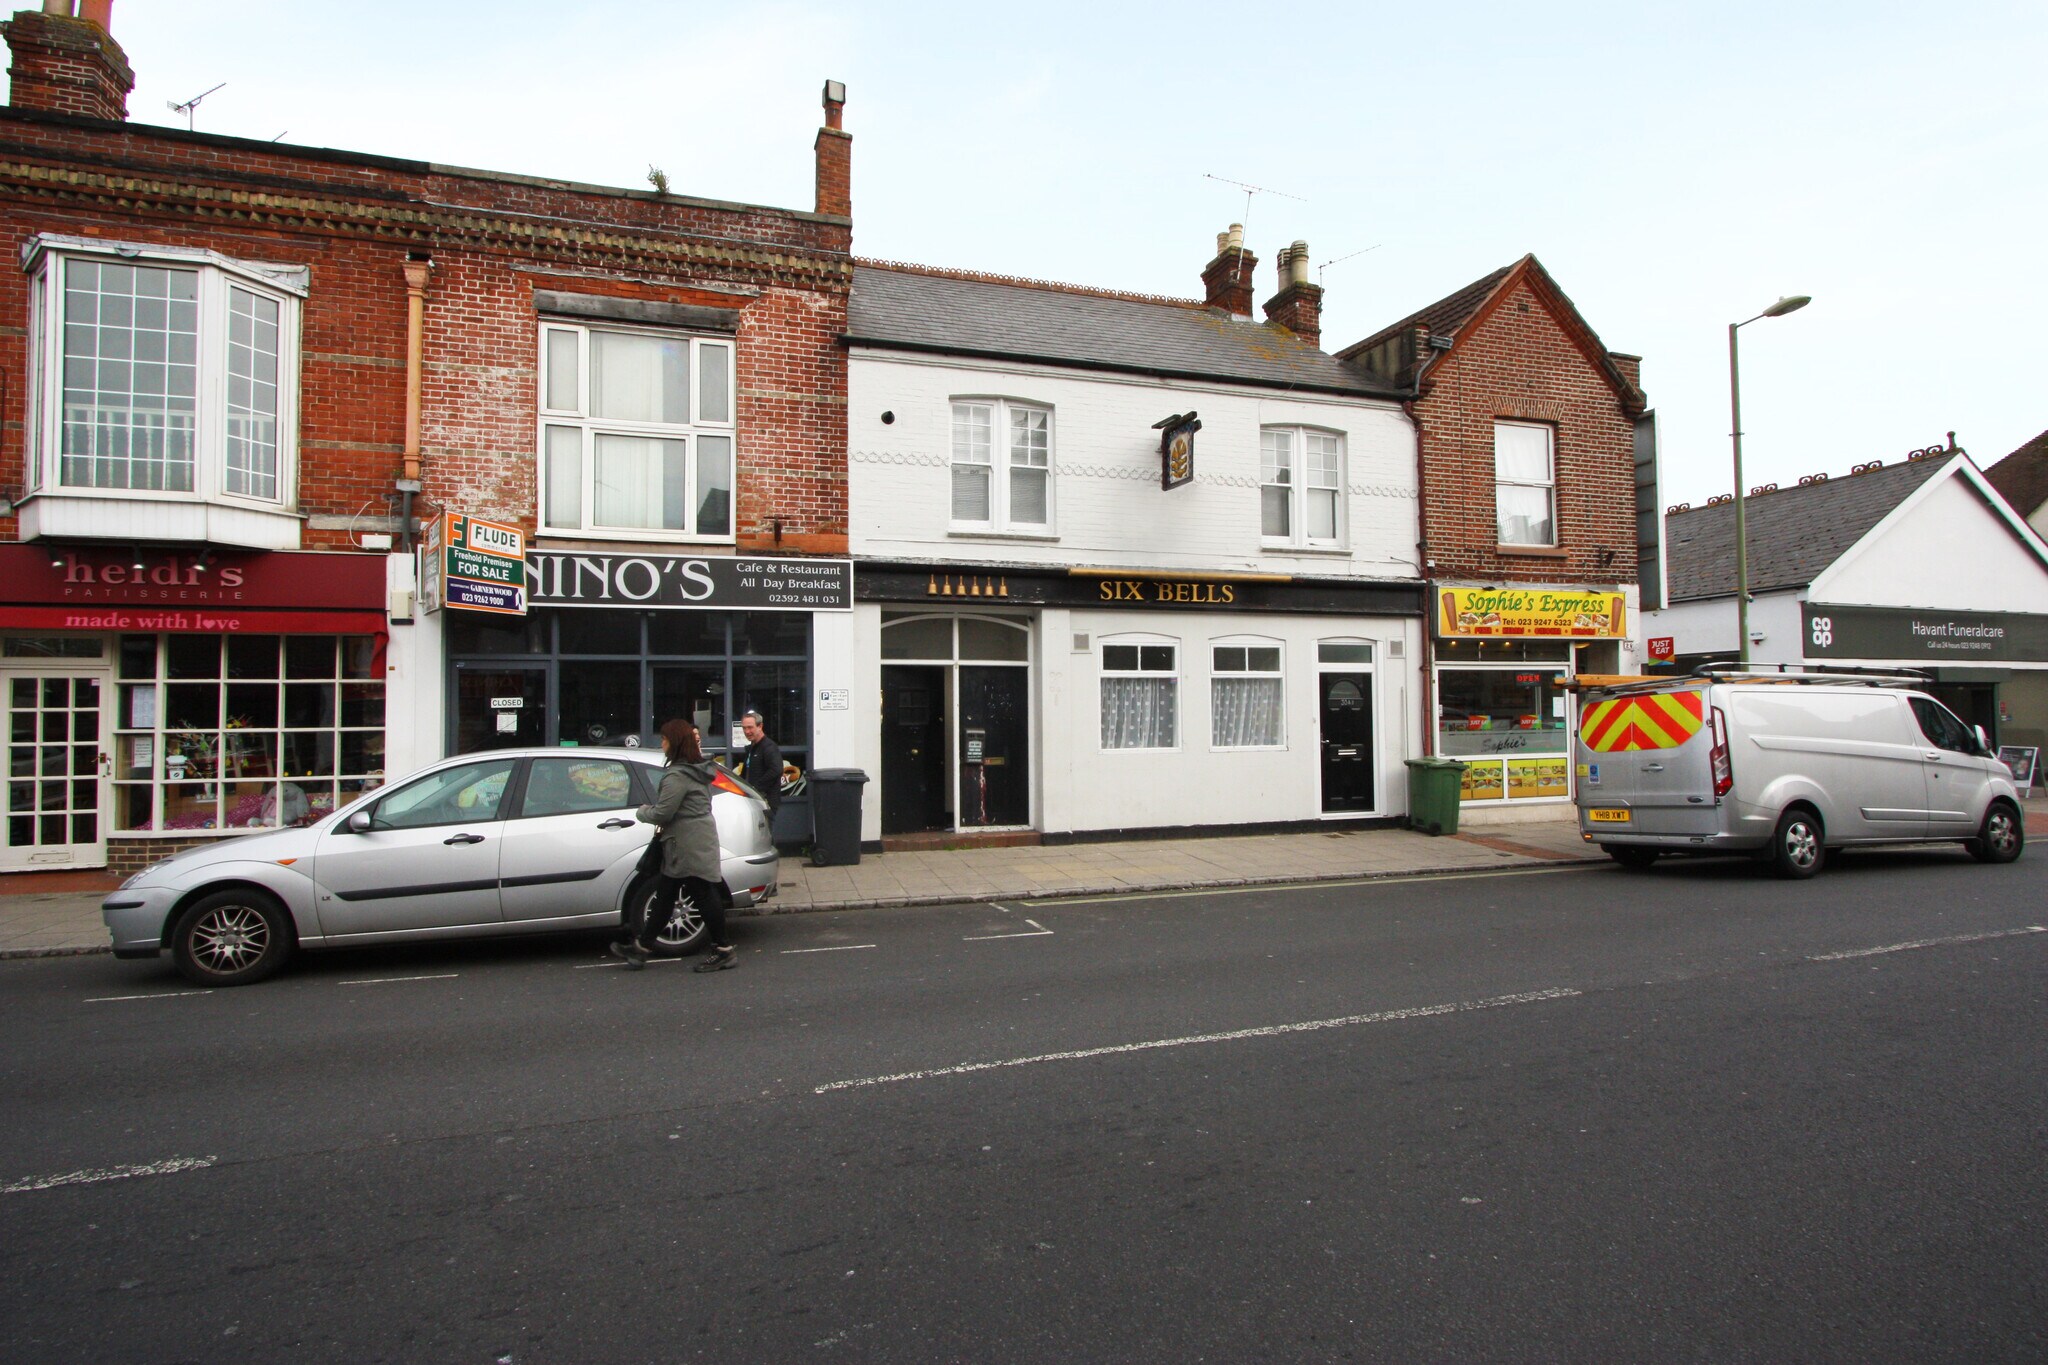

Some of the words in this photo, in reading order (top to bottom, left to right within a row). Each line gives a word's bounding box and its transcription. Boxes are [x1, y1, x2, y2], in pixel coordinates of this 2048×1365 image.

[475, 525, 516, 547] FLUDE
[454, 549, 482, 563] Freehold
[483, 556, 512, 568] Premises
[458, 561, 480, 576] FOR
[482, 566, 510, 580] SALE
[736, 563, 763, 573] Cafe
[766, 564, 777, 573] &
[781, 564, 841, 575] Restaurant
[470, 584, 494, 594] GARNER
[494, 587, 513, 596] WOOD
[740, 578, 755, 587] All
[763, 578, 784, 590] Day
[788, 579, 841, 590] Breakfast
[65, 588, 243, 599] PATISSERIE
[1100, 581, 1144, 600] SIX
[1154, 582, 1234, 603] BELLS
[461, 593, 473, 602] 023
[474, 594, 489, 604] 9262
[489, 597, 504, 605] 9000
[769, 594, 799, 602] 02392
[802, 595, 819, 603] 481
[1464, 590, 1534, 615] Sophie's
[1539, 594, 1604, 619] Express
[65, 612, 131, 628] made
[137, 613, 188, 629] with
[1503, 618, 1516, 626] Tel:
[1534, 618, 1551, 626] 9247
[1912, 621, 1947, 636] Havant
[1948, 622, 2004, 638] Funeralcare
[1652, 640, 1670, 649] JUST
[1656, 647, 1670, 655] EAT
[1516, 674, 1540, 682] OPEN
[492, 699, 522, 707] CLOSED
[1481, 736, 1528, 754] Sophie's
[1611, 811, 1626, 819] XWT
